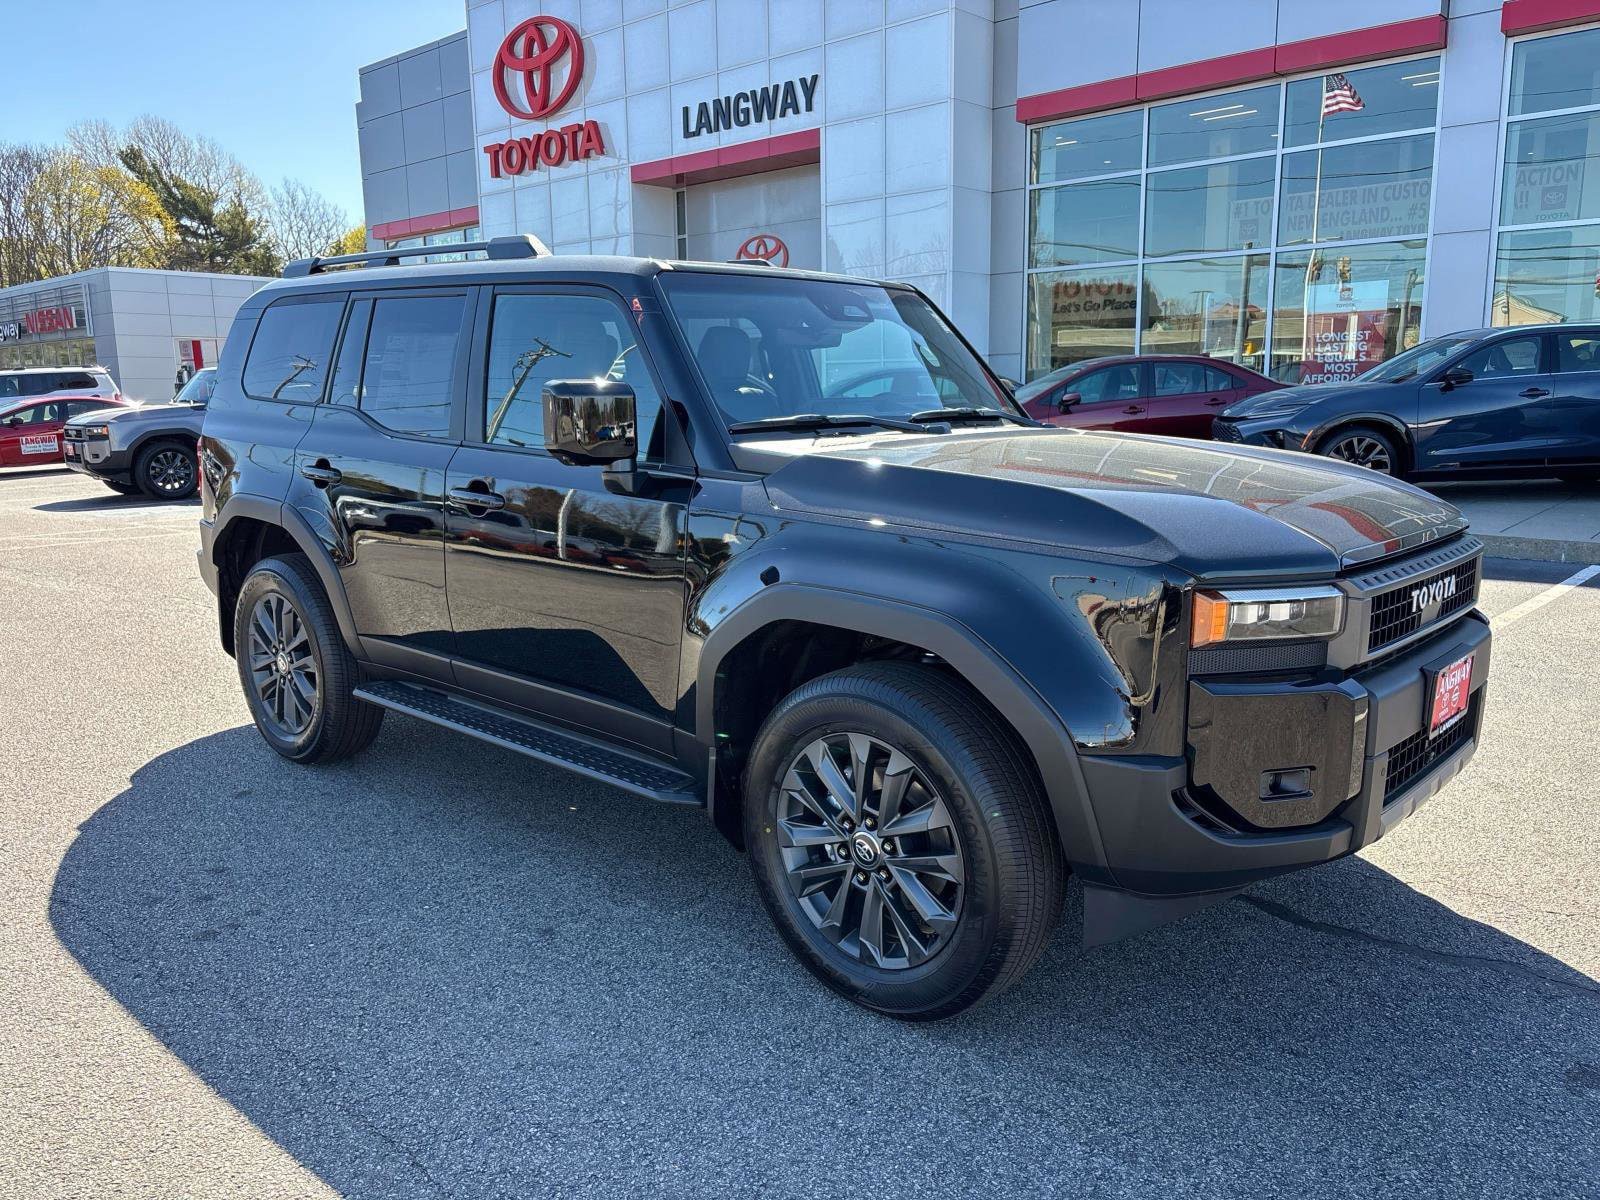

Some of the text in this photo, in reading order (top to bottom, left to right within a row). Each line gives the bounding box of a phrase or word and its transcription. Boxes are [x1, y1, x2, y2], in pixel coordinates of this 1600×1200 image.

[682, 74, 818, 139] LANGWAY
[484, 120, 605, 178] TOYOTA
[1516, 163, 1579, 187] ACTION
[1362, 186, 1378, 205] IN
[1053, 301, 1080, 314] Let's
[1083, 300, 1100, 312] Go
[25, 306, 75, 333] NISSAN
[1315, 330, 1371, 342] LONGEST
[1317, 342, 1368, 352] LASTING
[1317, 352, 1366, 363] EQUALS
[1324, 363, 1358, 373] MOST
[20, 436, 56, 445] LANGWAY
[1412, 575, 1456, 612] TOYOTA
